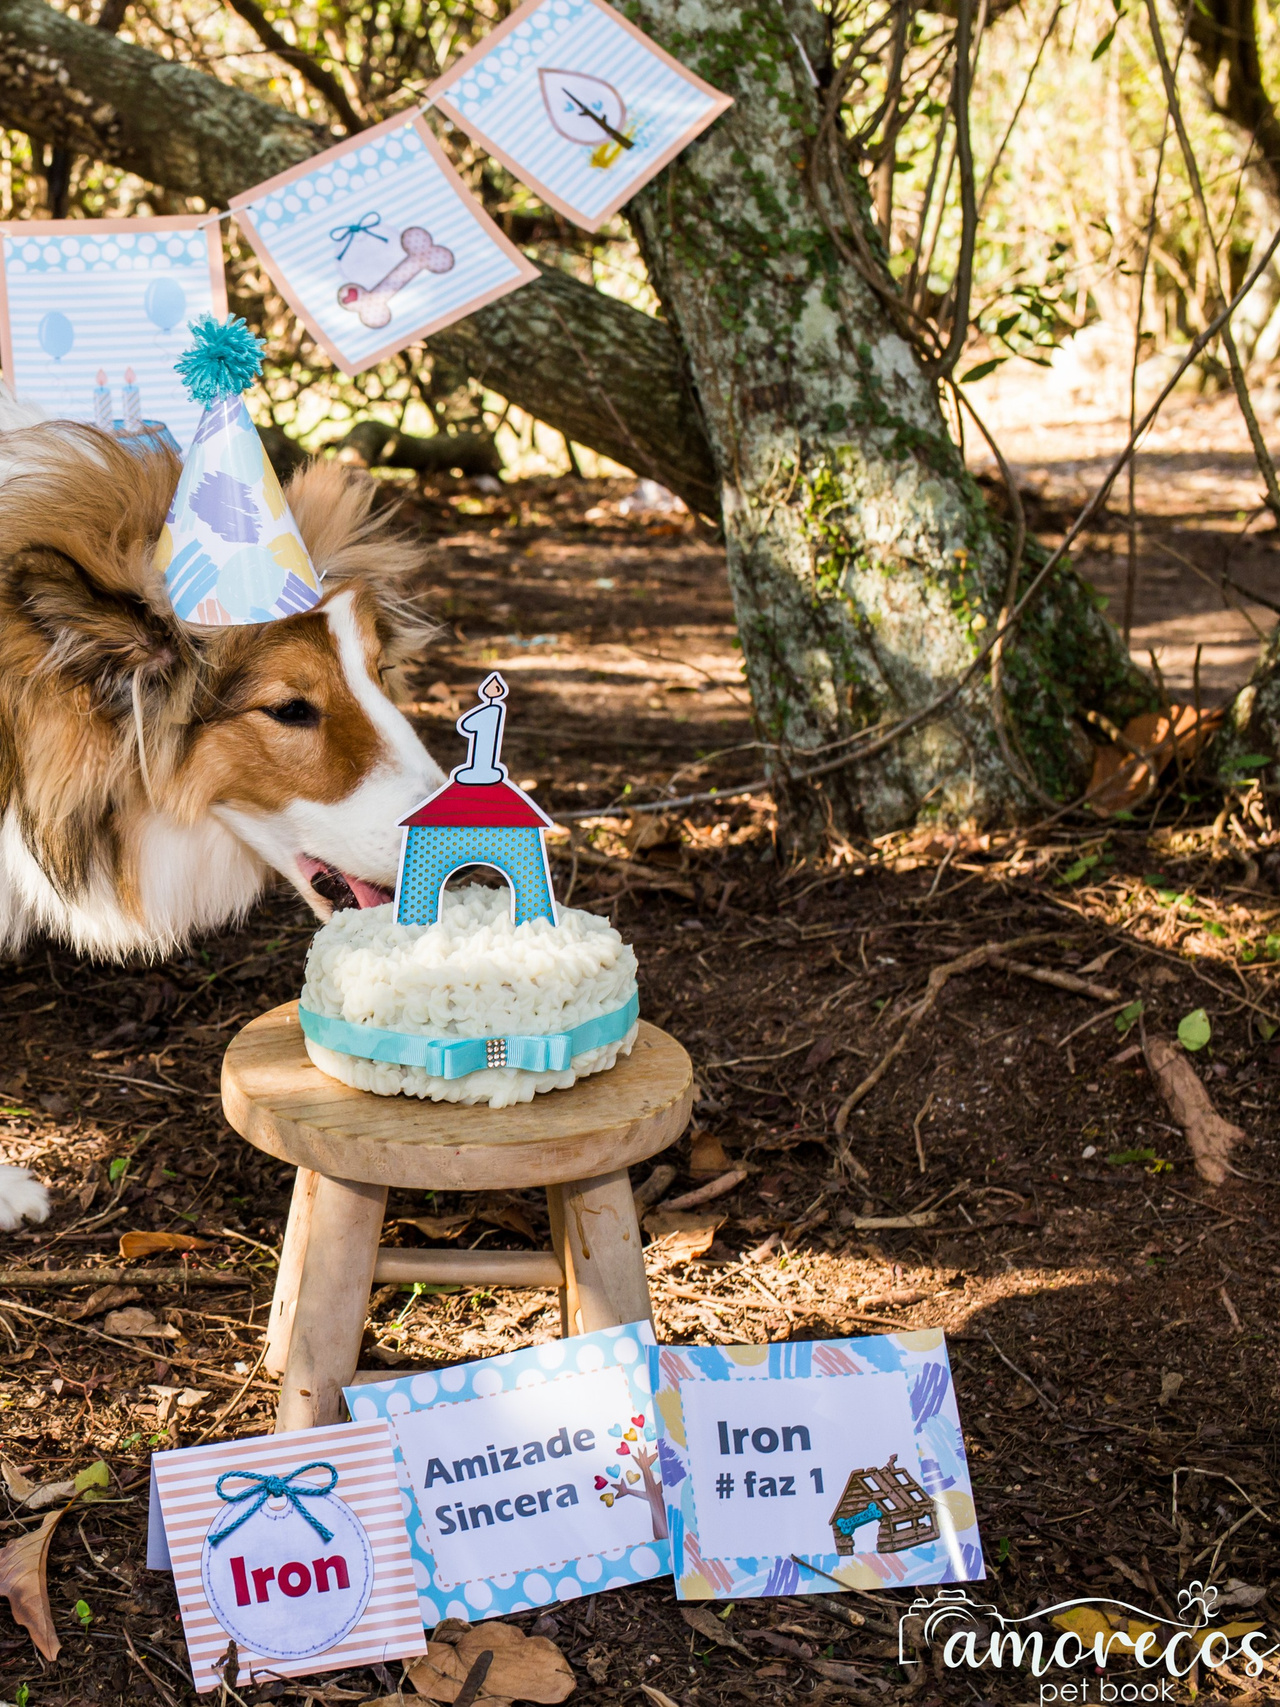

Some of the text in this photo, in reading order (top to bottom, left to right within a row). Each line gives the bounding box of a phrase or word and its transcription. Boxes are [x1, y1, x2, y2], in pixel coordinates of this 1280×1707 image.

[454, 702, 505, 785] 1
[423, 1427, 596, 1489] Amizade
[717, 1421, 812, 1455] Iron
[435, 1483, 580, 1535] Sincera
[716, 1467, 825, 1499] # faz 1
[229, 1554, 350, 1607] Iron
